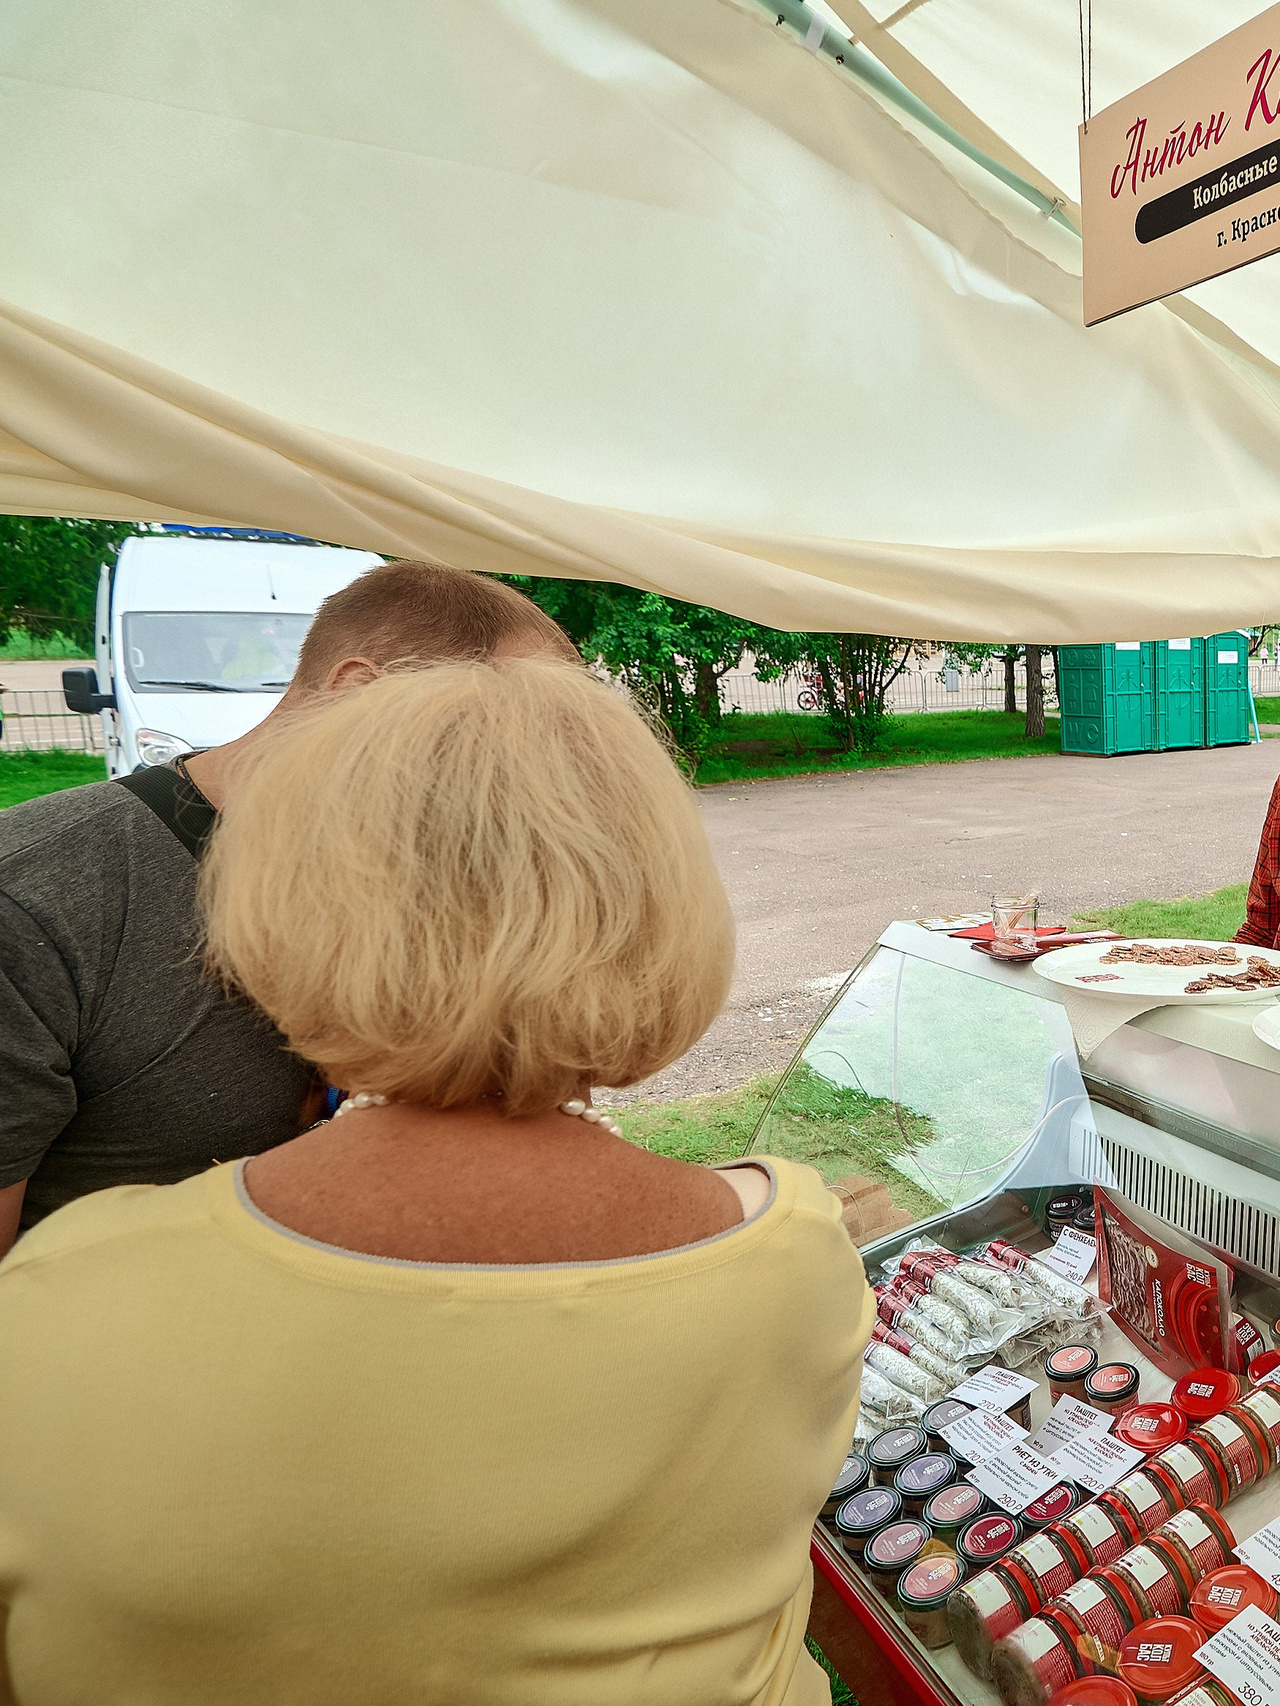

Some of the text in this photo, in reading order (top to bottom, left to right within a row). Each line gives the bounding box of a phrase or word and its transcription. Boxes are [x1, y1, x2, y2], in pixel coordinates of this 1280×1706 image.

[1110, 111, 1231, 199] Антон
[1192, 153, 1277, 210] Колбасные
[1217, 228, 1227, 247] г.
[1068, 1231, 1097, 1247] ФЕНХЕЛЕ
[1065, 1269, 1078, 1280] 240
[1186, 1263, 1197, 1282] БАС
[1195, 1266, 1205, 1285] КОЛ
[1237, 1327, 1251, 1342] КОЛ
[1242, 1322, 1256, 1338] БАС
[995, 1370, 1019, 1382] ПАШТЕТ
[977, 1399, 995, 1409] 270
[1073, 1404, 1098, 1420] ПАШТЕТ
[1100, 1437, 1126, 1453] ПАШТЕТ
[965, 1450, 979, 1463] 210
[1011, 1445, 1058, 1479] РИЕТ ИЗ УТКИ
[1078, 1474, 1097, 1487] 220
[996, 1493, 1016, 1507] 290
[1207, 1585, 1223, 1602] БАС
[1219, 1587, 1235, 1605] КОЛ
[1136, 1643, 1152, 1661] БАС
[1149, 1644, 1164, 1662] КОЛ
[1208, 1643, 1226, 1657] нотами
[1244, 1642, 1263, 1658] паштет
[1237, 1681, 1262, 1706] 380
